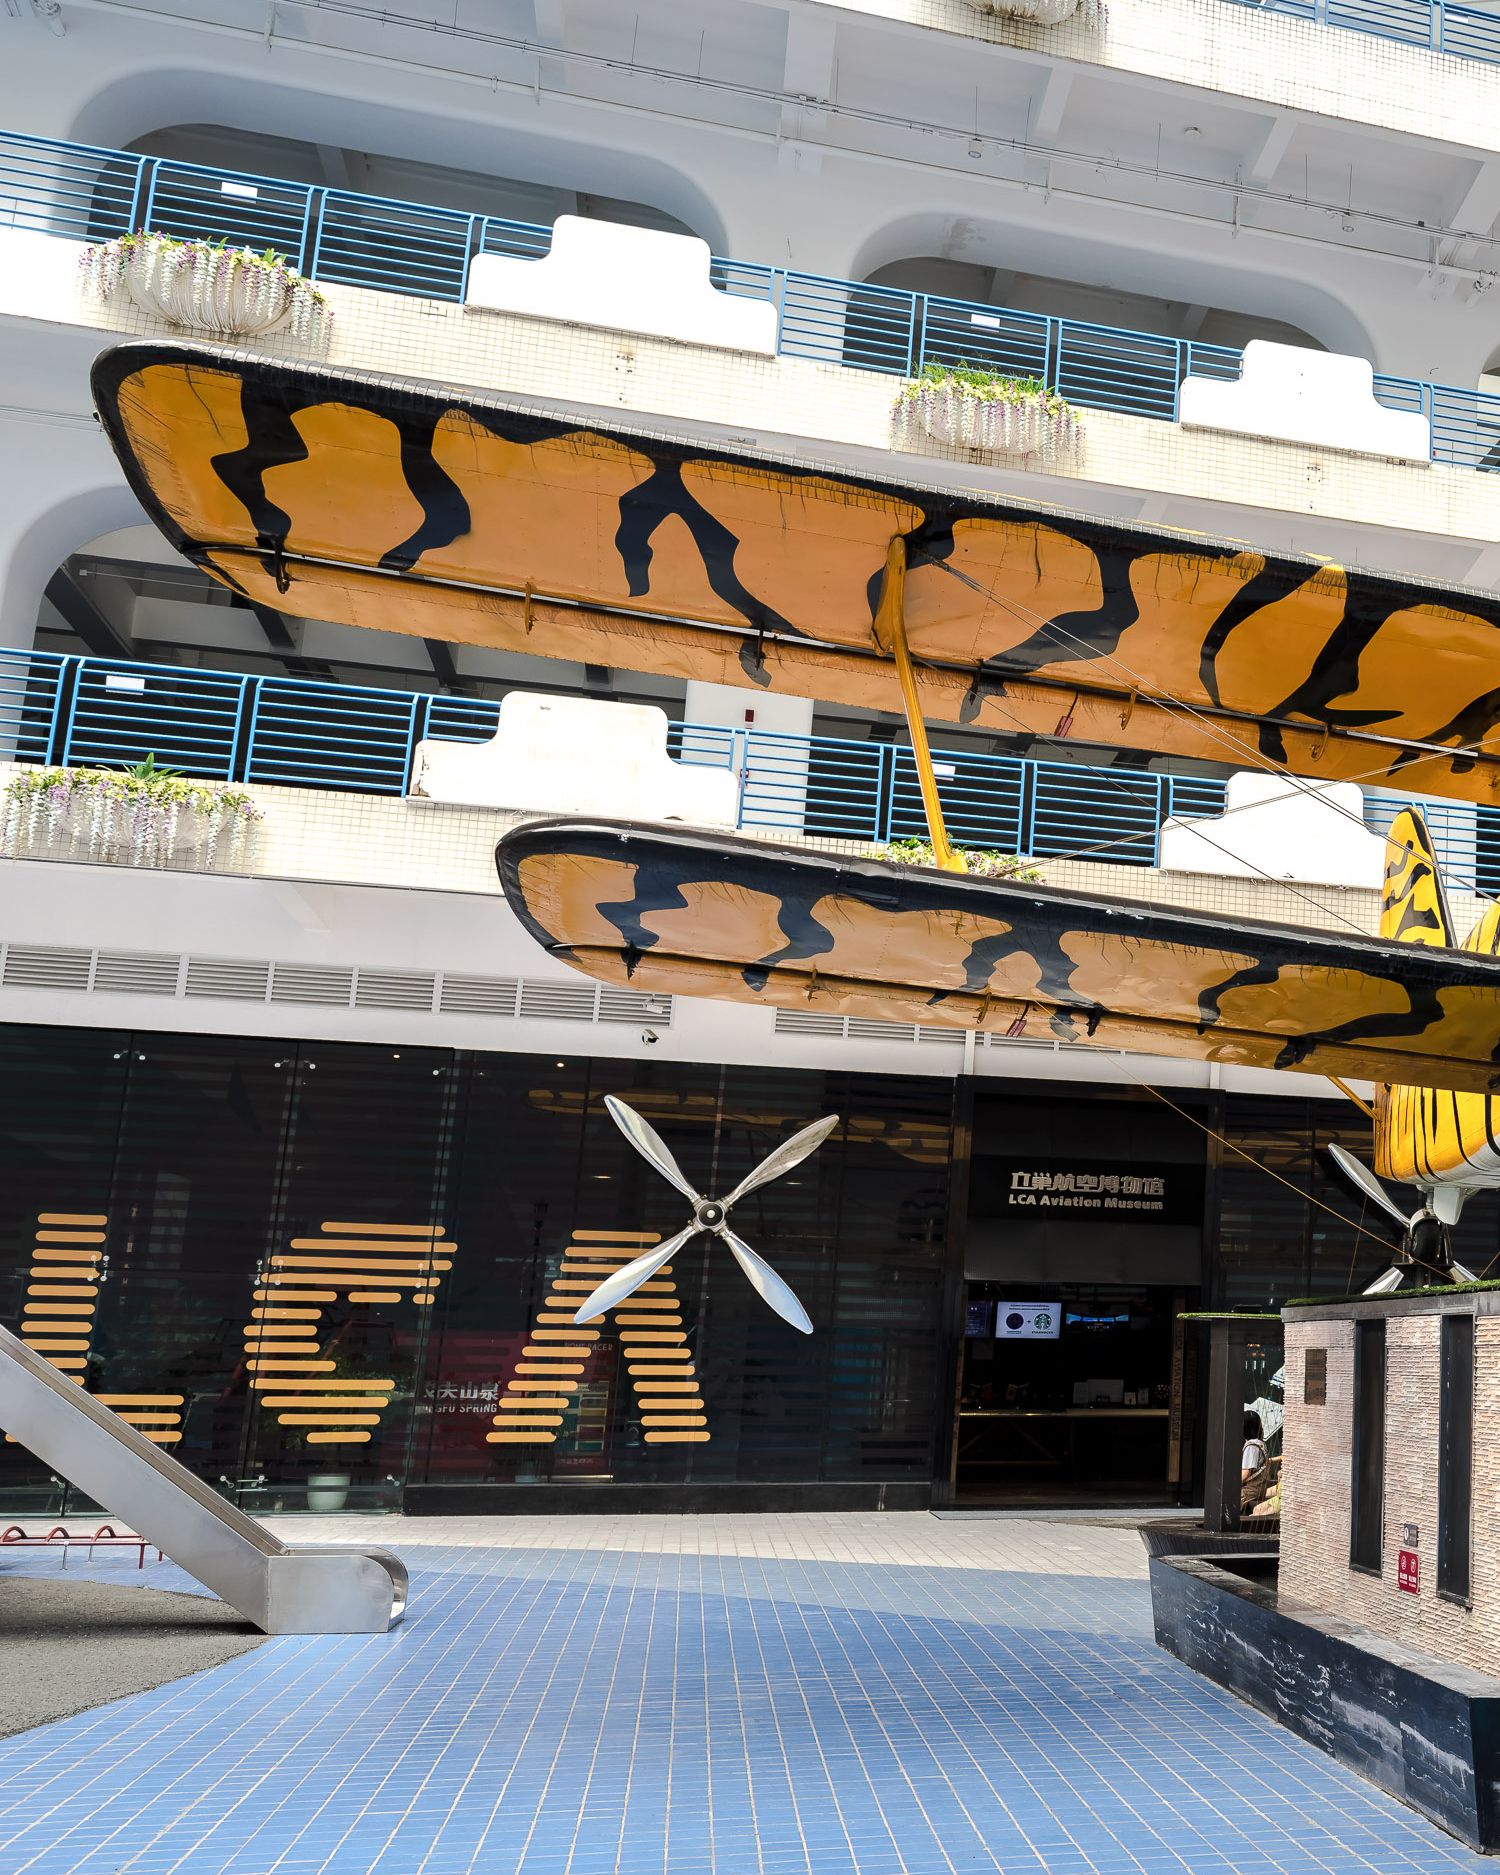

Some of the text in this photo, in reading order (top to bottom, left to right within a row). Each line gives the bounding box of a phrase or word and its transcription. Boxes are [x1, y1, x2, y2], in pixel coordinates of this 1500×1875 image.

[1010, 1171, 1165, 1196] 立巢航空博物馆
[1009, 1193, 1164, 1211] LCA Aviation Museum
[459, 1403, 498, 1414] SPRING
